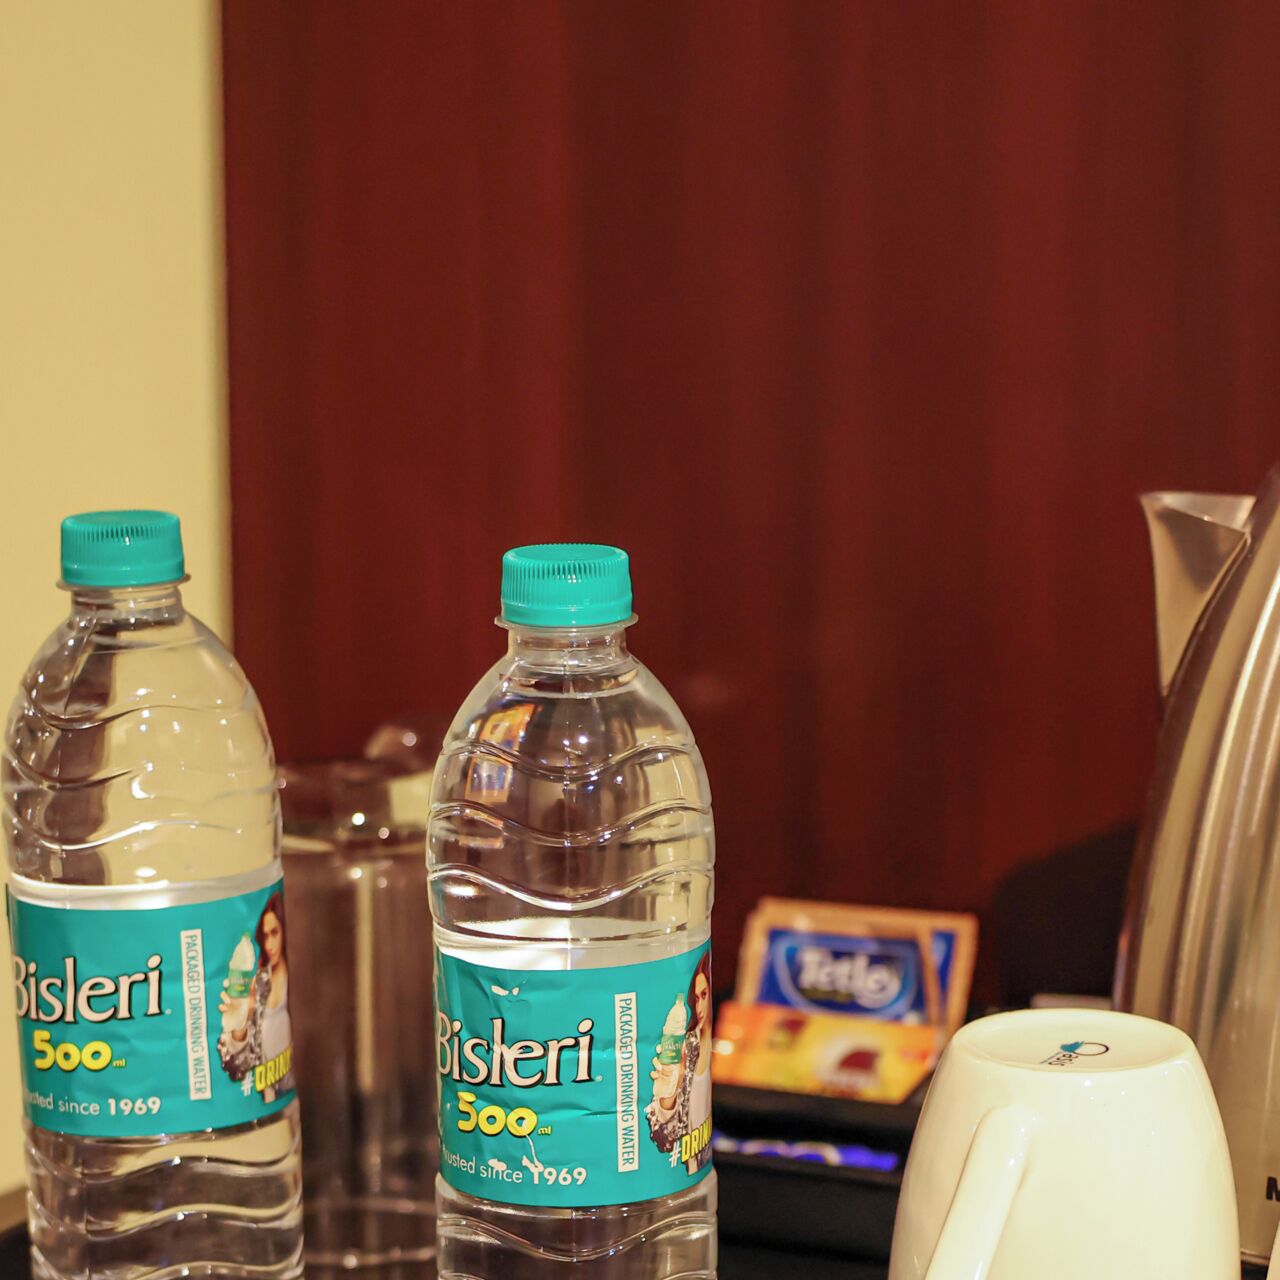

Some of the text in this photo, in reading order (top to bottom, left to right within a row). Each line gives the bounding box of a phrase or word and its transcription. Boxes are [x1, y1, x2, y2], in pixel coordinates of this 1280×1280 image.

[12, 953, 164, 1024] Bisleri
[185, 934, 207, 1094] PACKAGED DRINKING WATER
[33, 1029, 113, 1072] 500
[436, 1011, 595, 1088] Bisleri
[58, 1096, 101, 1116] since
[107, 1096, 162, 1117] 1969
[618, 997, 635, 1167] PACKAGED DRINKING WATER
[456, 1091, 539, 1138] 500
[479, 1158, 524, 1184] since
[531, 1166, 588, 1186] 1969
